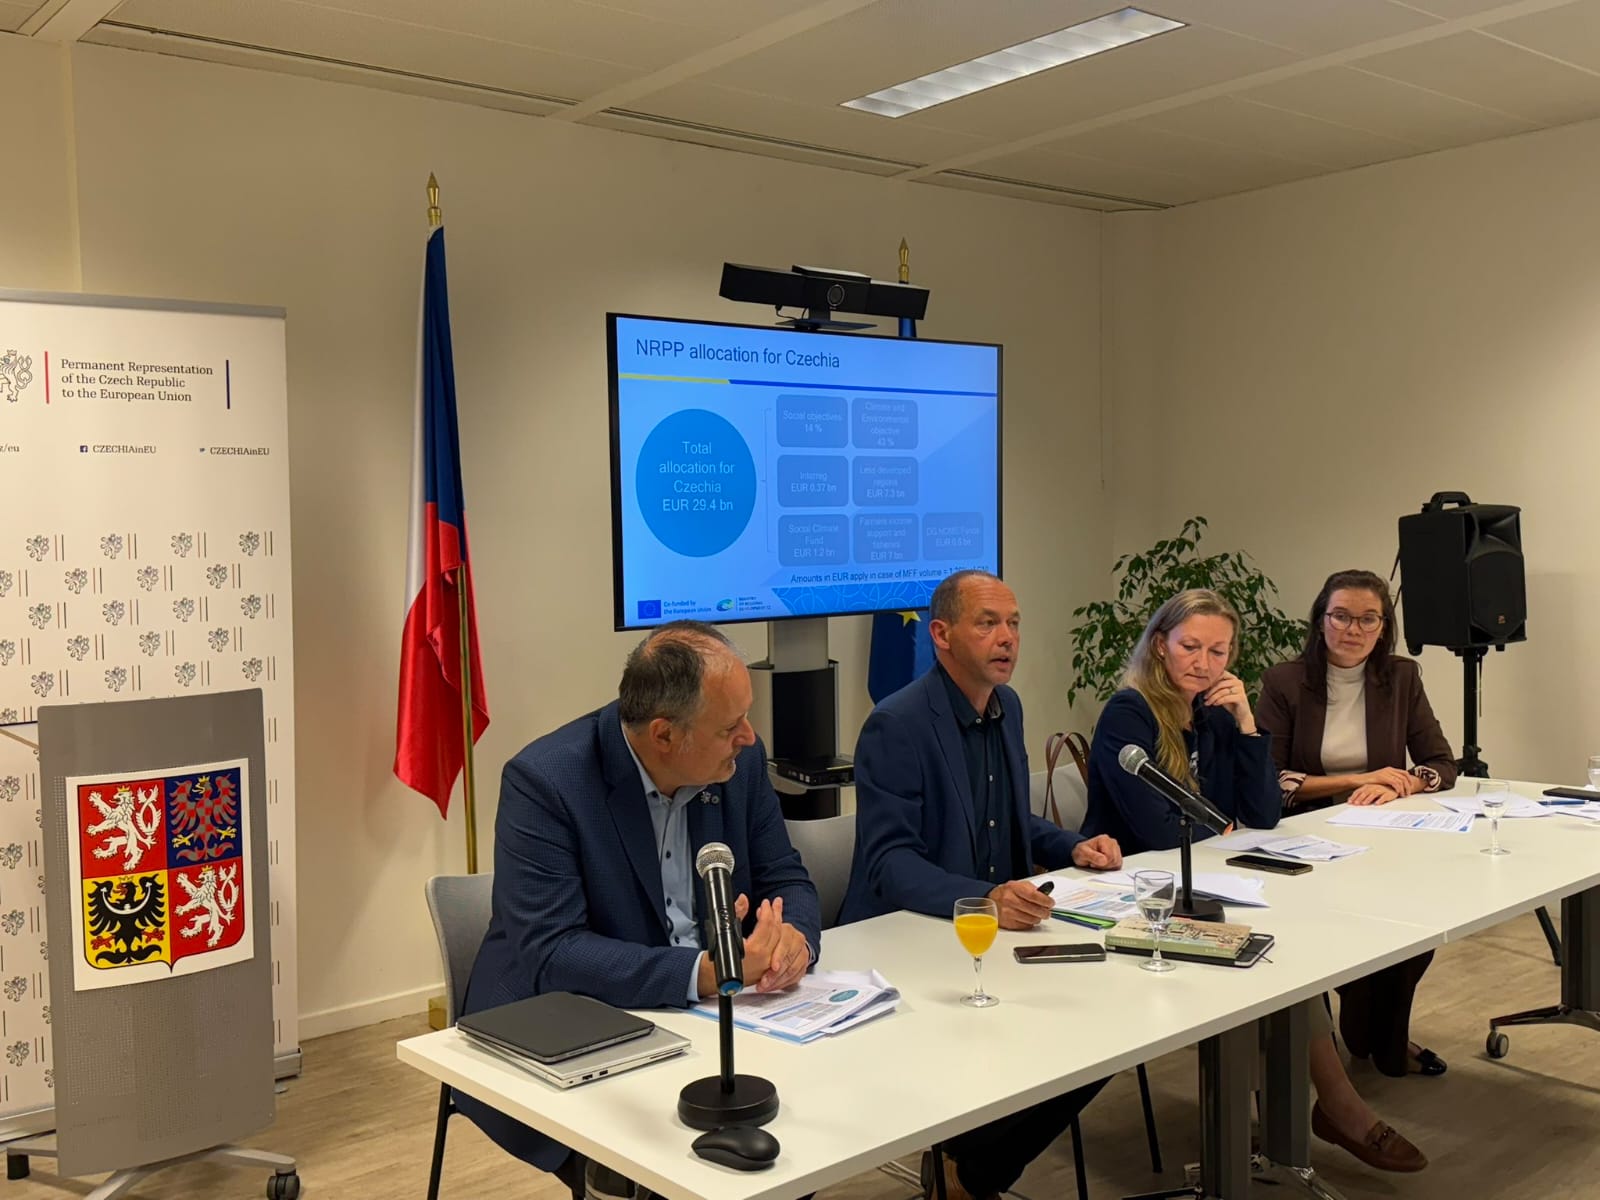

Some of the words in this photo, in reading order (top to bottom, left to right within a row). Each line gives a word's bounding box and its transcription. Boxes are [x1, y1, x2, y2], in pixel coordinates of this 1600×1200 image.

[636, 338, 685, 358] NRPP
[689, 343, 759, 364] allocation
[763, 347, 782, 365] for
[785, 349, 840, 369] Czechia
[60, 358, 125, 372] Permanent
[127, 360, 213, 376] Representation
[61, 372, 74, 384] of
[76, 373, 96, 384] the
[98, 374, 134, 386] Czech
[136, 375, 187, 389] Republic
[61, 388, 74, 398] to
[77, 387, 97, 399] the
[99, 388, 155, 402] European
[157, 390, 193, 402] Union
[783, 409, 806, 421] Social
[92, 445, 157, 454] CZECHIAinEU
[209, 446, 271, 456] CZECHIAinEU
[681, 440, 712, 455] Total
[658, 460, 716, 474] allocation
[719, 460, 734, 474] for
[673, 479, 721, 494] Czechia
[791, 483, 808, 493] EUR
[866, 488, 883, 499] EUR
[662, 498, 689, 512] EUR
[692, 498, 716, 512] 29.4
[720, 498, 733, 512] bn
[788, 523, 811, 533] Social
[805, 535, 824, 545] Fund
[794, 547, 811, 558] EUR
[871, 551, 887, 561] EUR
[791, 573, 822, 584] Amounts
[824, 574, 831, 582] in
[832, 572, 849, 582] EUR
[850, 571, 868, 584] apply
[869, 571, 876, 580] in
[877, 571, 893, 580] case
[895, 568, 903, 578] of
[903, 568, 918, 578] MFF
[919, 567, 942, 577] volume
